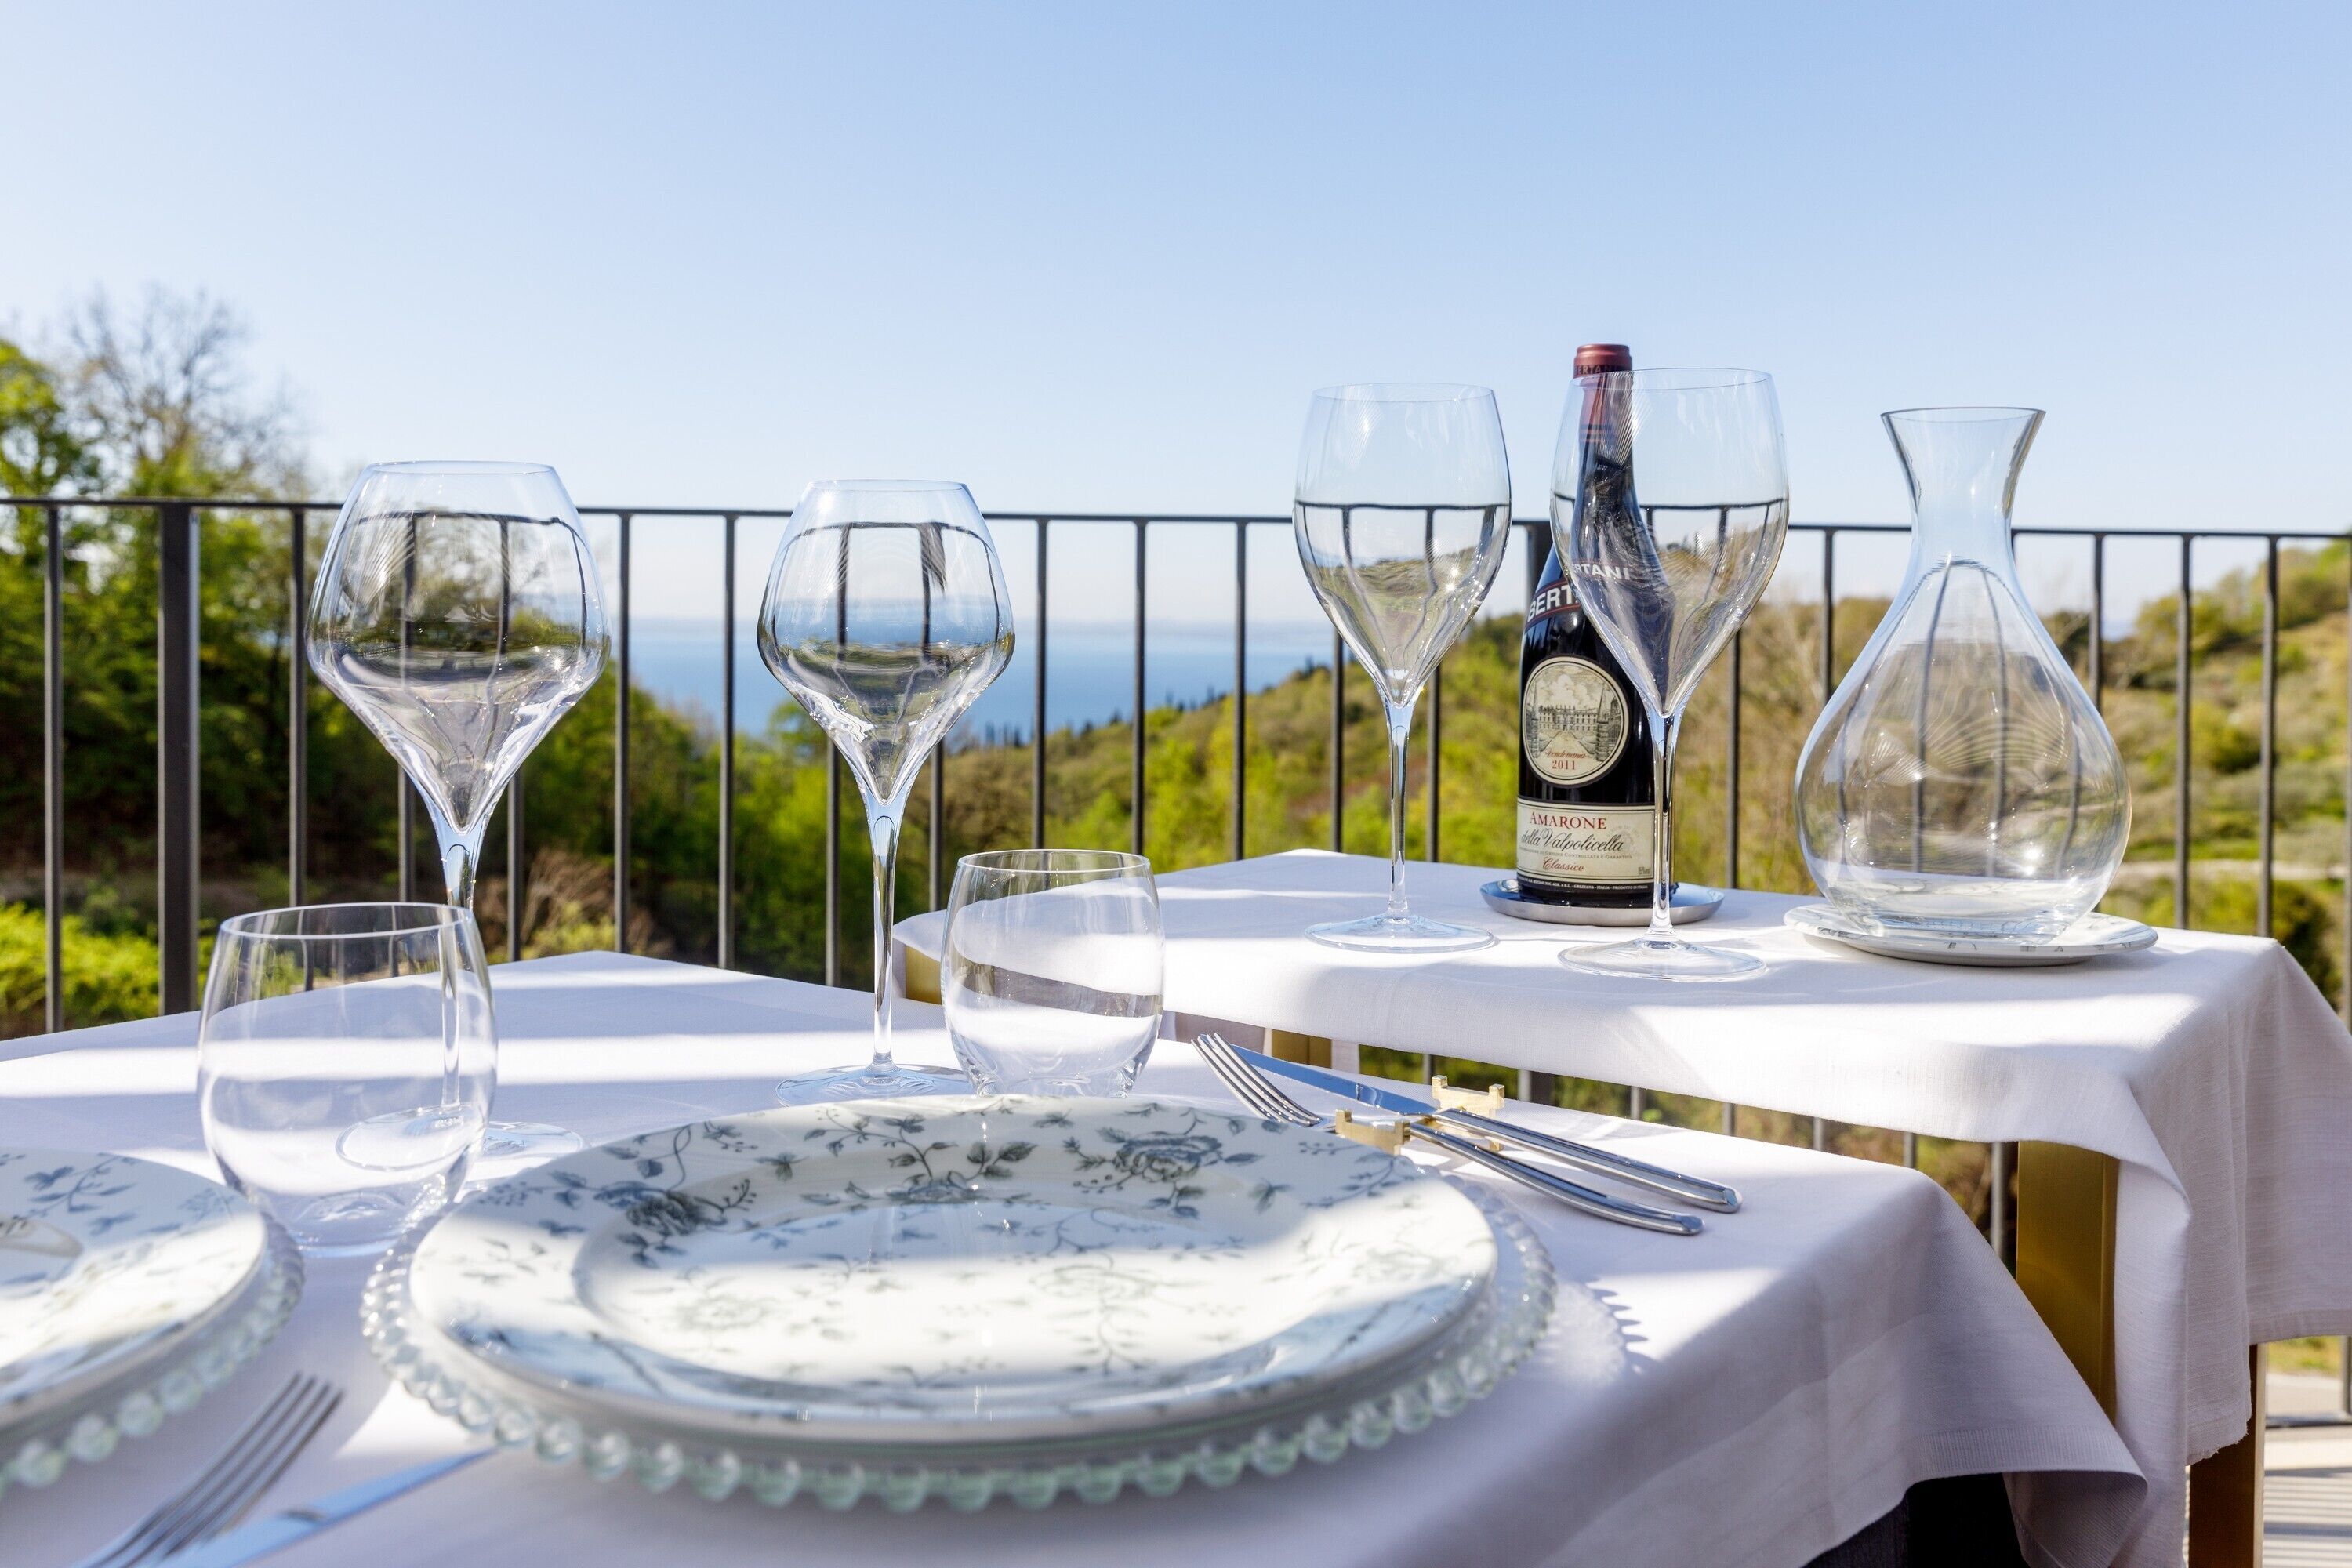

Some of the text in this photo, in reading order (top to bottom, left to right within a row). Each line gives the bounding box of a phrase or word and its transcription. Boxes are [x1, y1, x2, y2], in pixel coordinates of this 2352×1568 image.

[1527, 584, 1577, 622] BERT
[1552, 760, 1575, 770] 2011
[1530, 811, 1607, 829] AMARONE
[1521, 827, 1541, 847] della
[1540, 829, 1624, 851] Valpolicella
[1543, 856, 1584, 872] Classico
